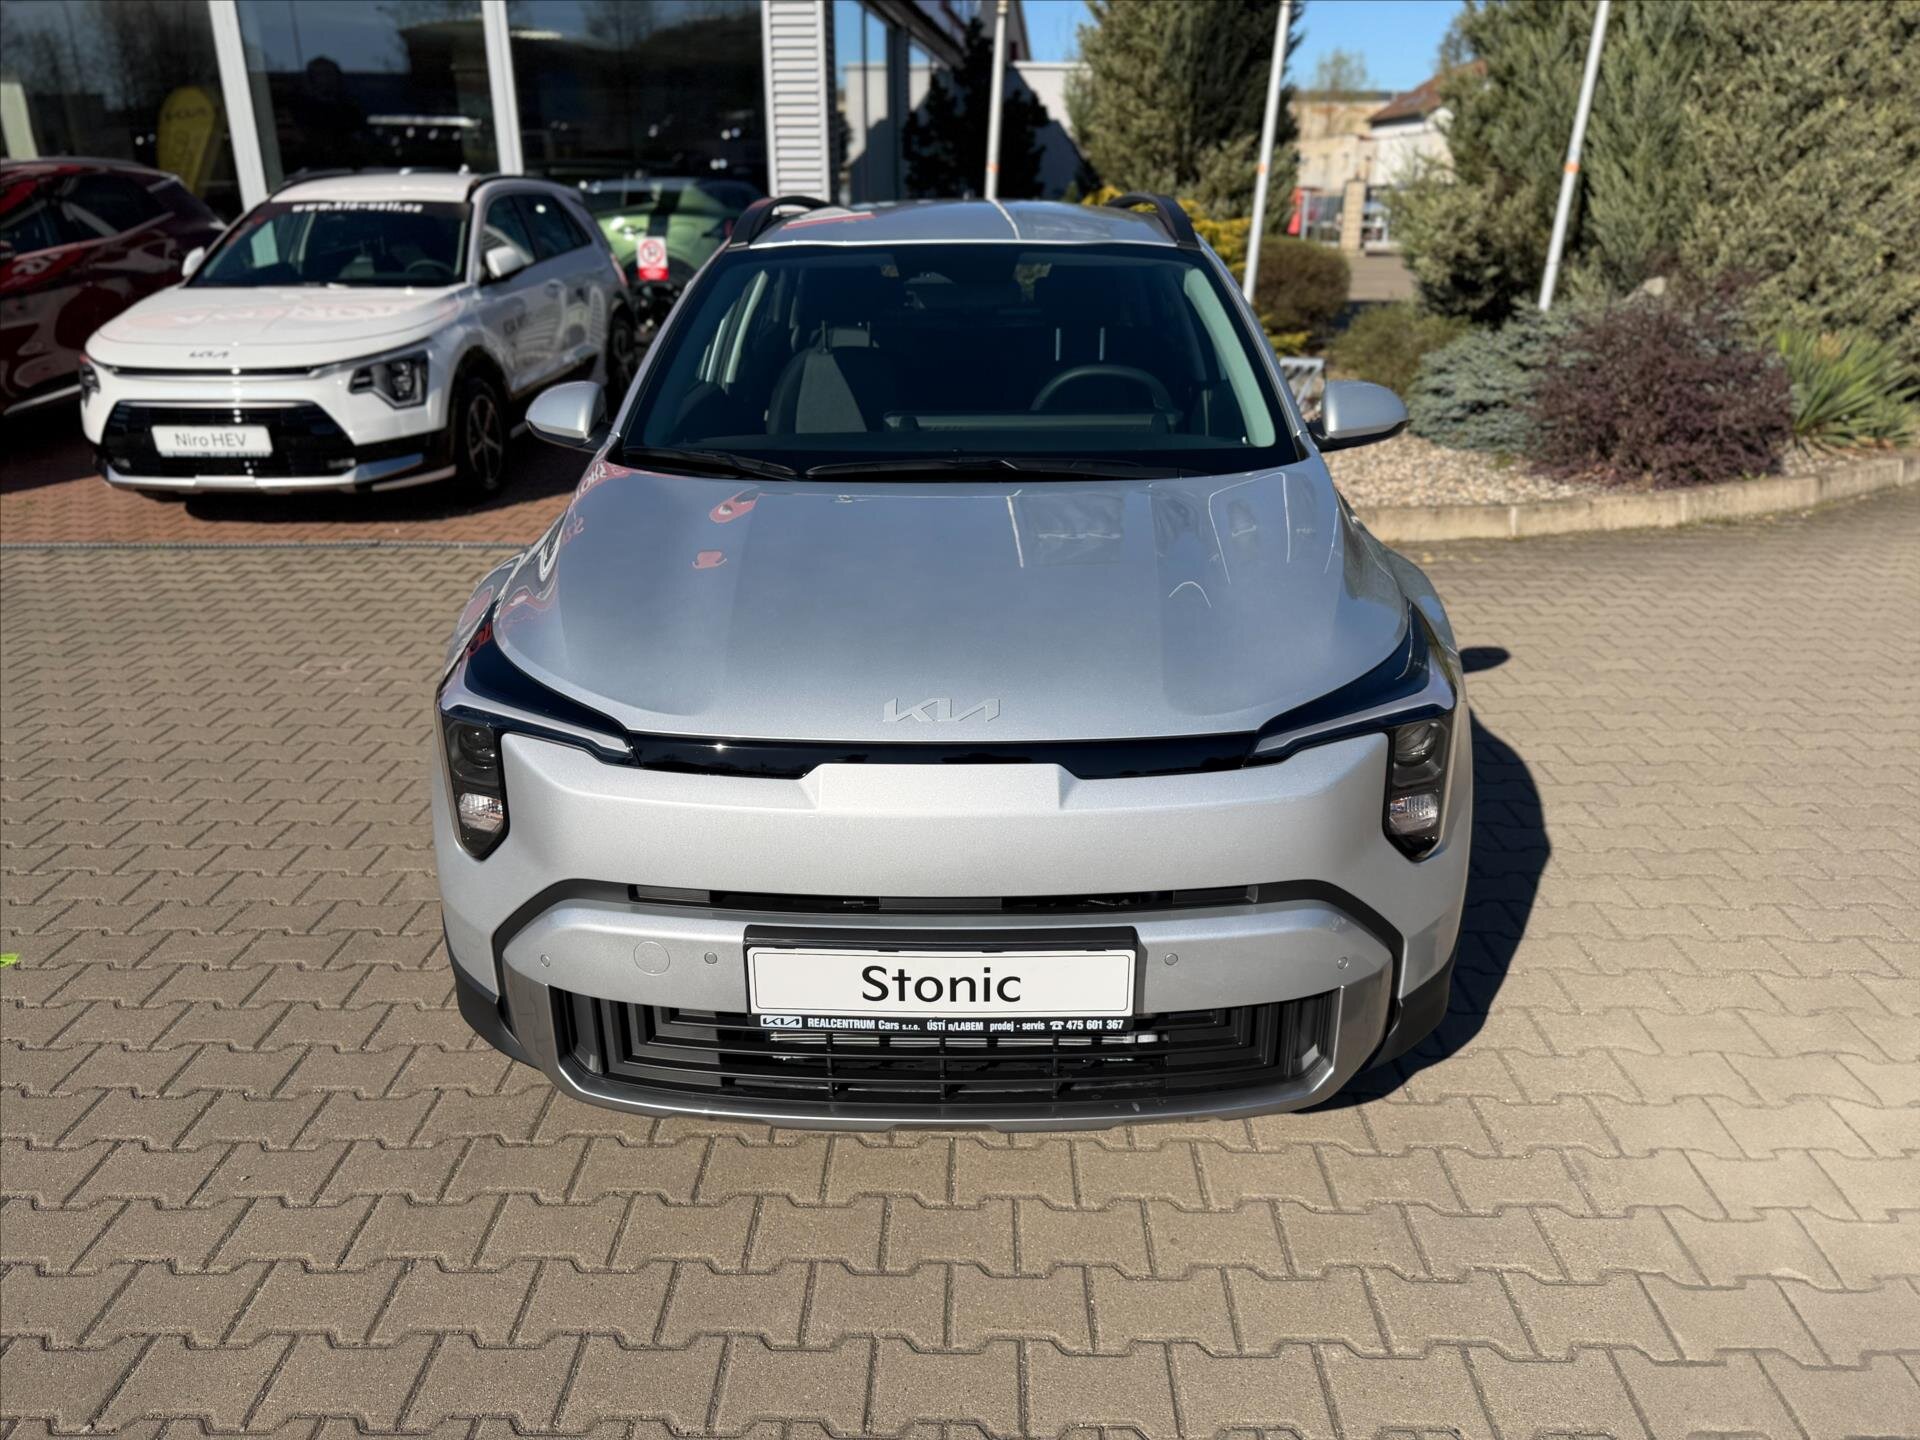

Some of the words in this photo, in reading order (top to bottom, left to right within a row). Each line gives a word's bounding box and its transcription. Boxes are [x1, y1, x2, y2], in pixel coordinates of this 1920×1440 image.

[174, 432, 209, 447] Niro
[211, 432, 246, 447] HEV
[883, 698, 1001, 721] KIA
[861, 965, 1021, 1002] Stonic
[762, 1016, 800, 1027] KIA
[807, 1017, 876, 1030] REALCENTRUM
[878, 1020, 900, 1031] Cars
[902, 1023, 920, 1031] s.r.o.
[926, 1018, 946, 1031] ÚSTÍ
[948, 1020, 984, 1031] n/LABEM
[989, 1020, 1014, 1033] prodej
[1022, 1020, 1046, 1031] servis
[1066, 1019, 1084, 1031] 475
[1086, 1019, 1103, 1030] 601
[1106, 1018, 1124, 1030] 367
